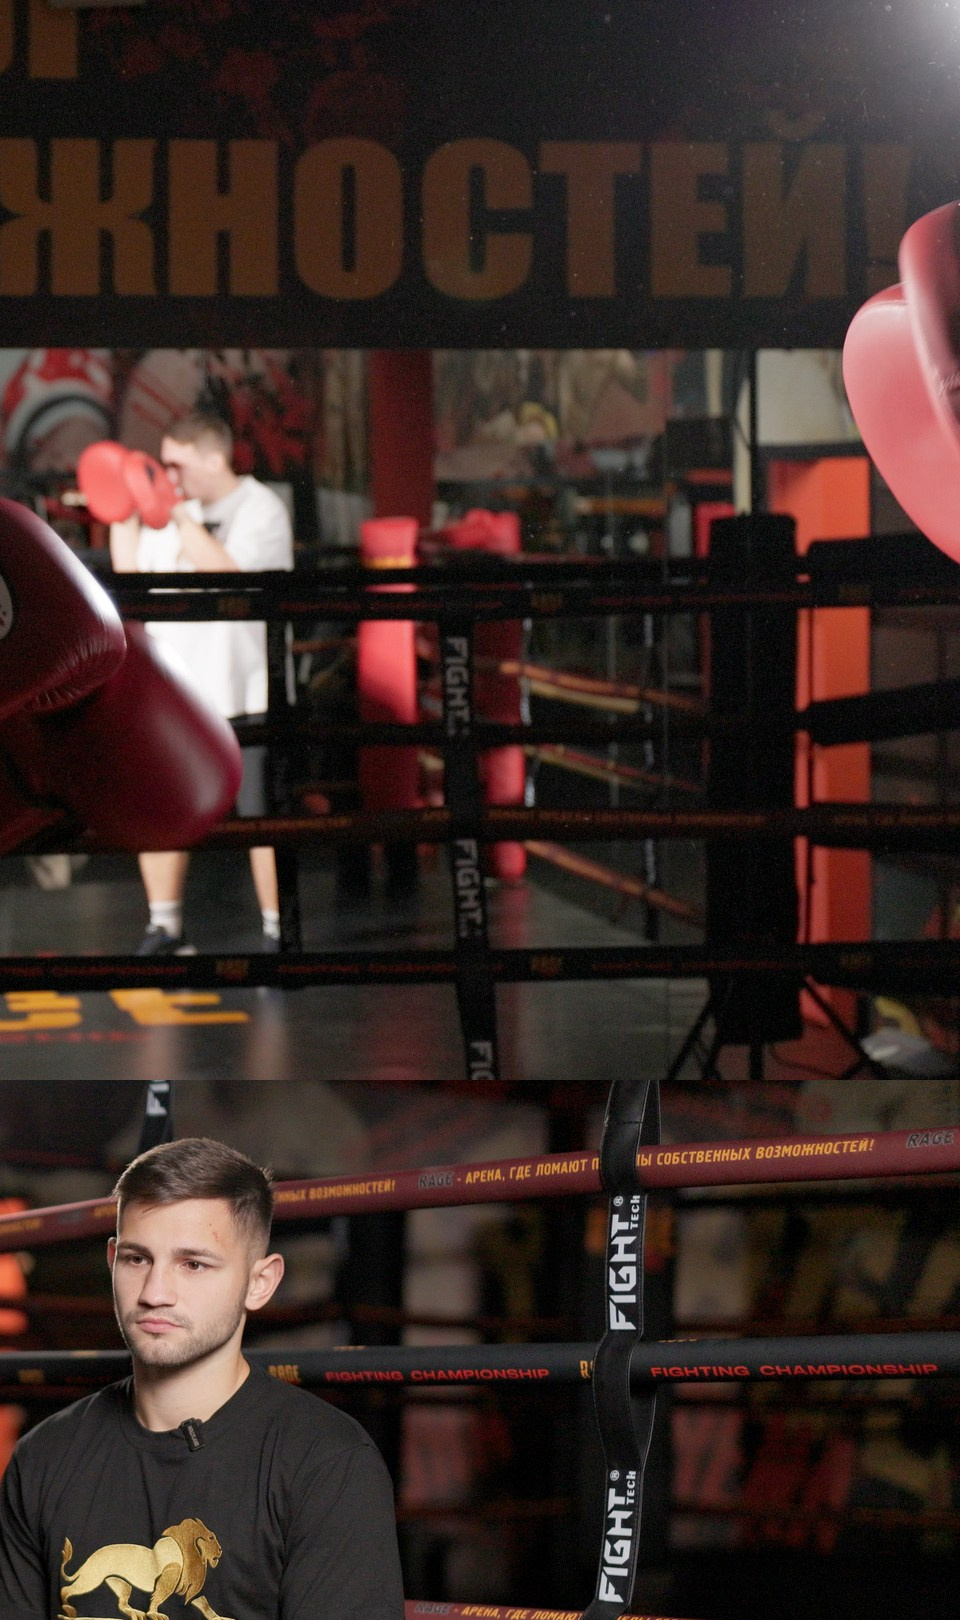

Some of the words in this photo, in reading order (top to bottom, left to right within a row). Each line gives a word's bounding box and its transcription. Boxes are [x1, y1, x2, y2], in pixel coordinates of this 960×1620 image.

[444, 636, 470, 722] FIGHT
[454, 838, 483, 925] FIGHT
[465, 1168, 505, 1184] АРЕНА,
[509, 1165, 532, 1180] ГДЕ
[536, 1159, 588, 1176] ЛОМАЮТ
[657, 1147, 751, 1166] СОБСТВЕННЫХ
[755, 1138, 875, 1160] ВОЗМОЖНОСТЕЙ!
[906, 1130, 957, 1149] RAGE
[608, 1214, 638, 1331] FIGHT
[324, 1370, 406, 1383] FIGHTING
[410, 1368, 551, 1381] CHAMPIONSHIP
[650, 1366, 751, 1378] FIGHTING
[758, 1363, 940, 1377] CHAMPIONSHIP
[598, 1487, 634, 1603] FIGHT
[461, 1606, 501, 1619] АРЕНА,
[505, 1609, 528, 1620] ГДЕ
